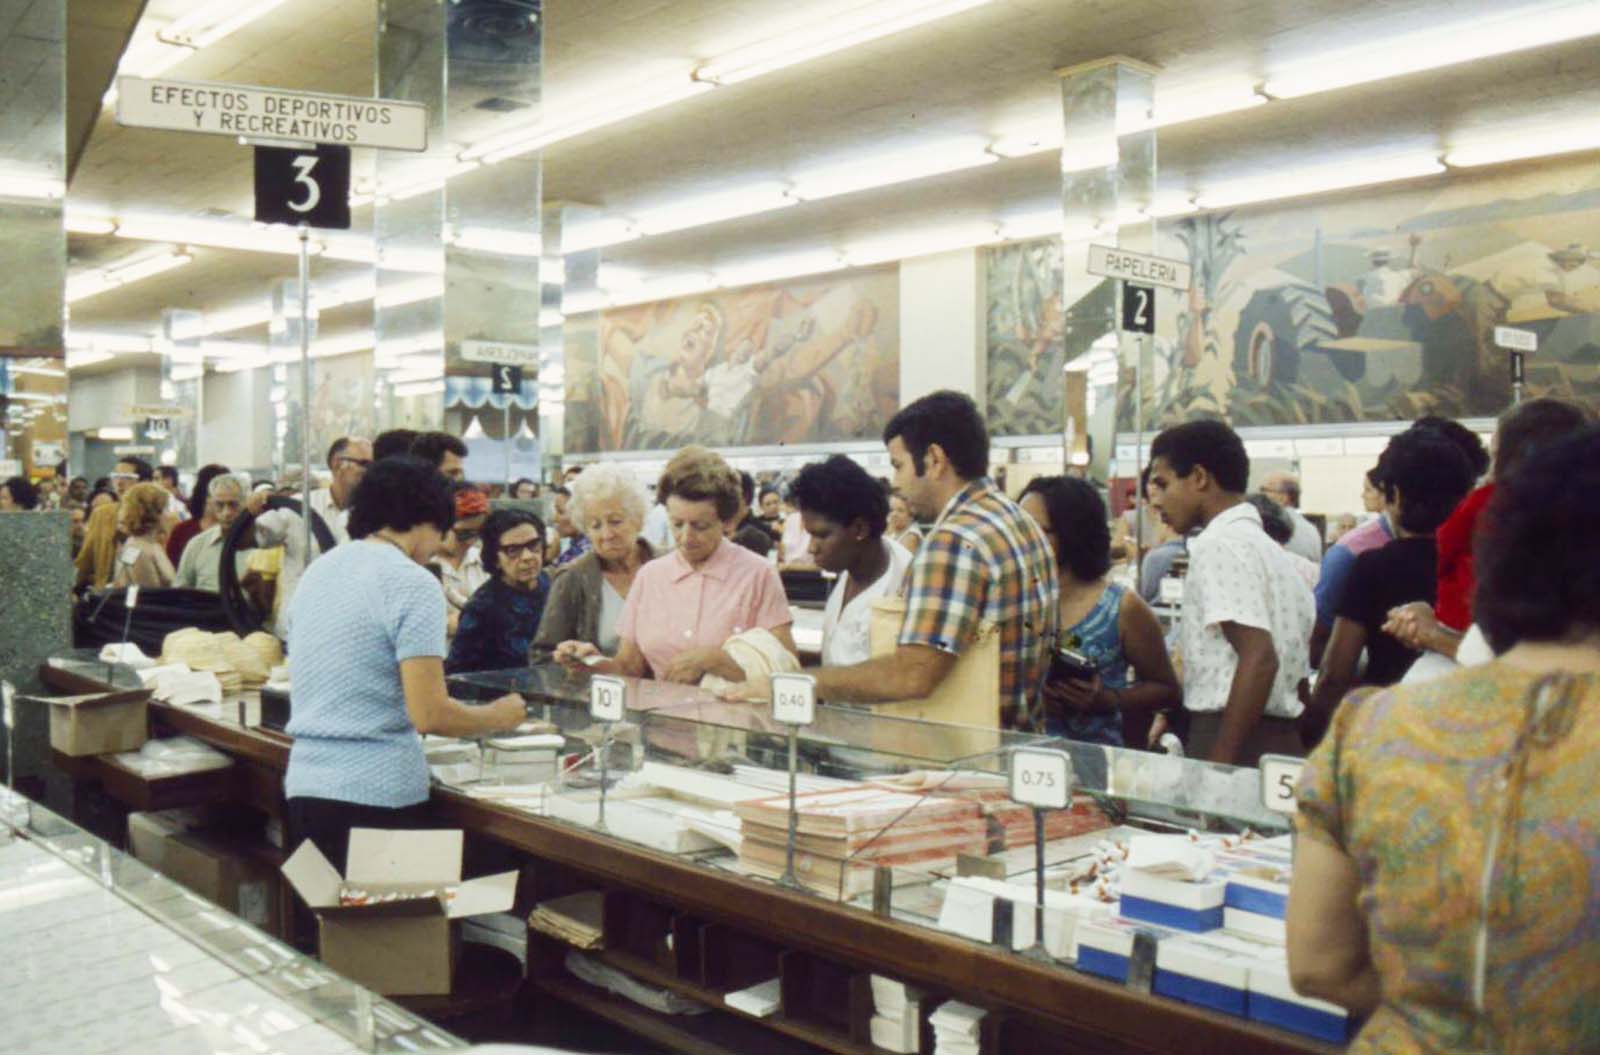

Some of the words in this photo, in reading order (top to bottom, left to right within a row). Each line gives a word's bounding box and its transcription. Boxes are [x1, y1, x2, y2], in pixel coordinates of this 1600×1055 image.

[151, 85, 248, 111] EFECTOS
[264, 96, 392, 125] DEPORTIVOS
[193, 111, 203, 127] Y
[220, 113, 357, 141] RECREATIVOS
[286, 155, 321, 213] 3
[1133, 289, 1148, 325] 2
[1022, 769, 1055, 787] 0.75
